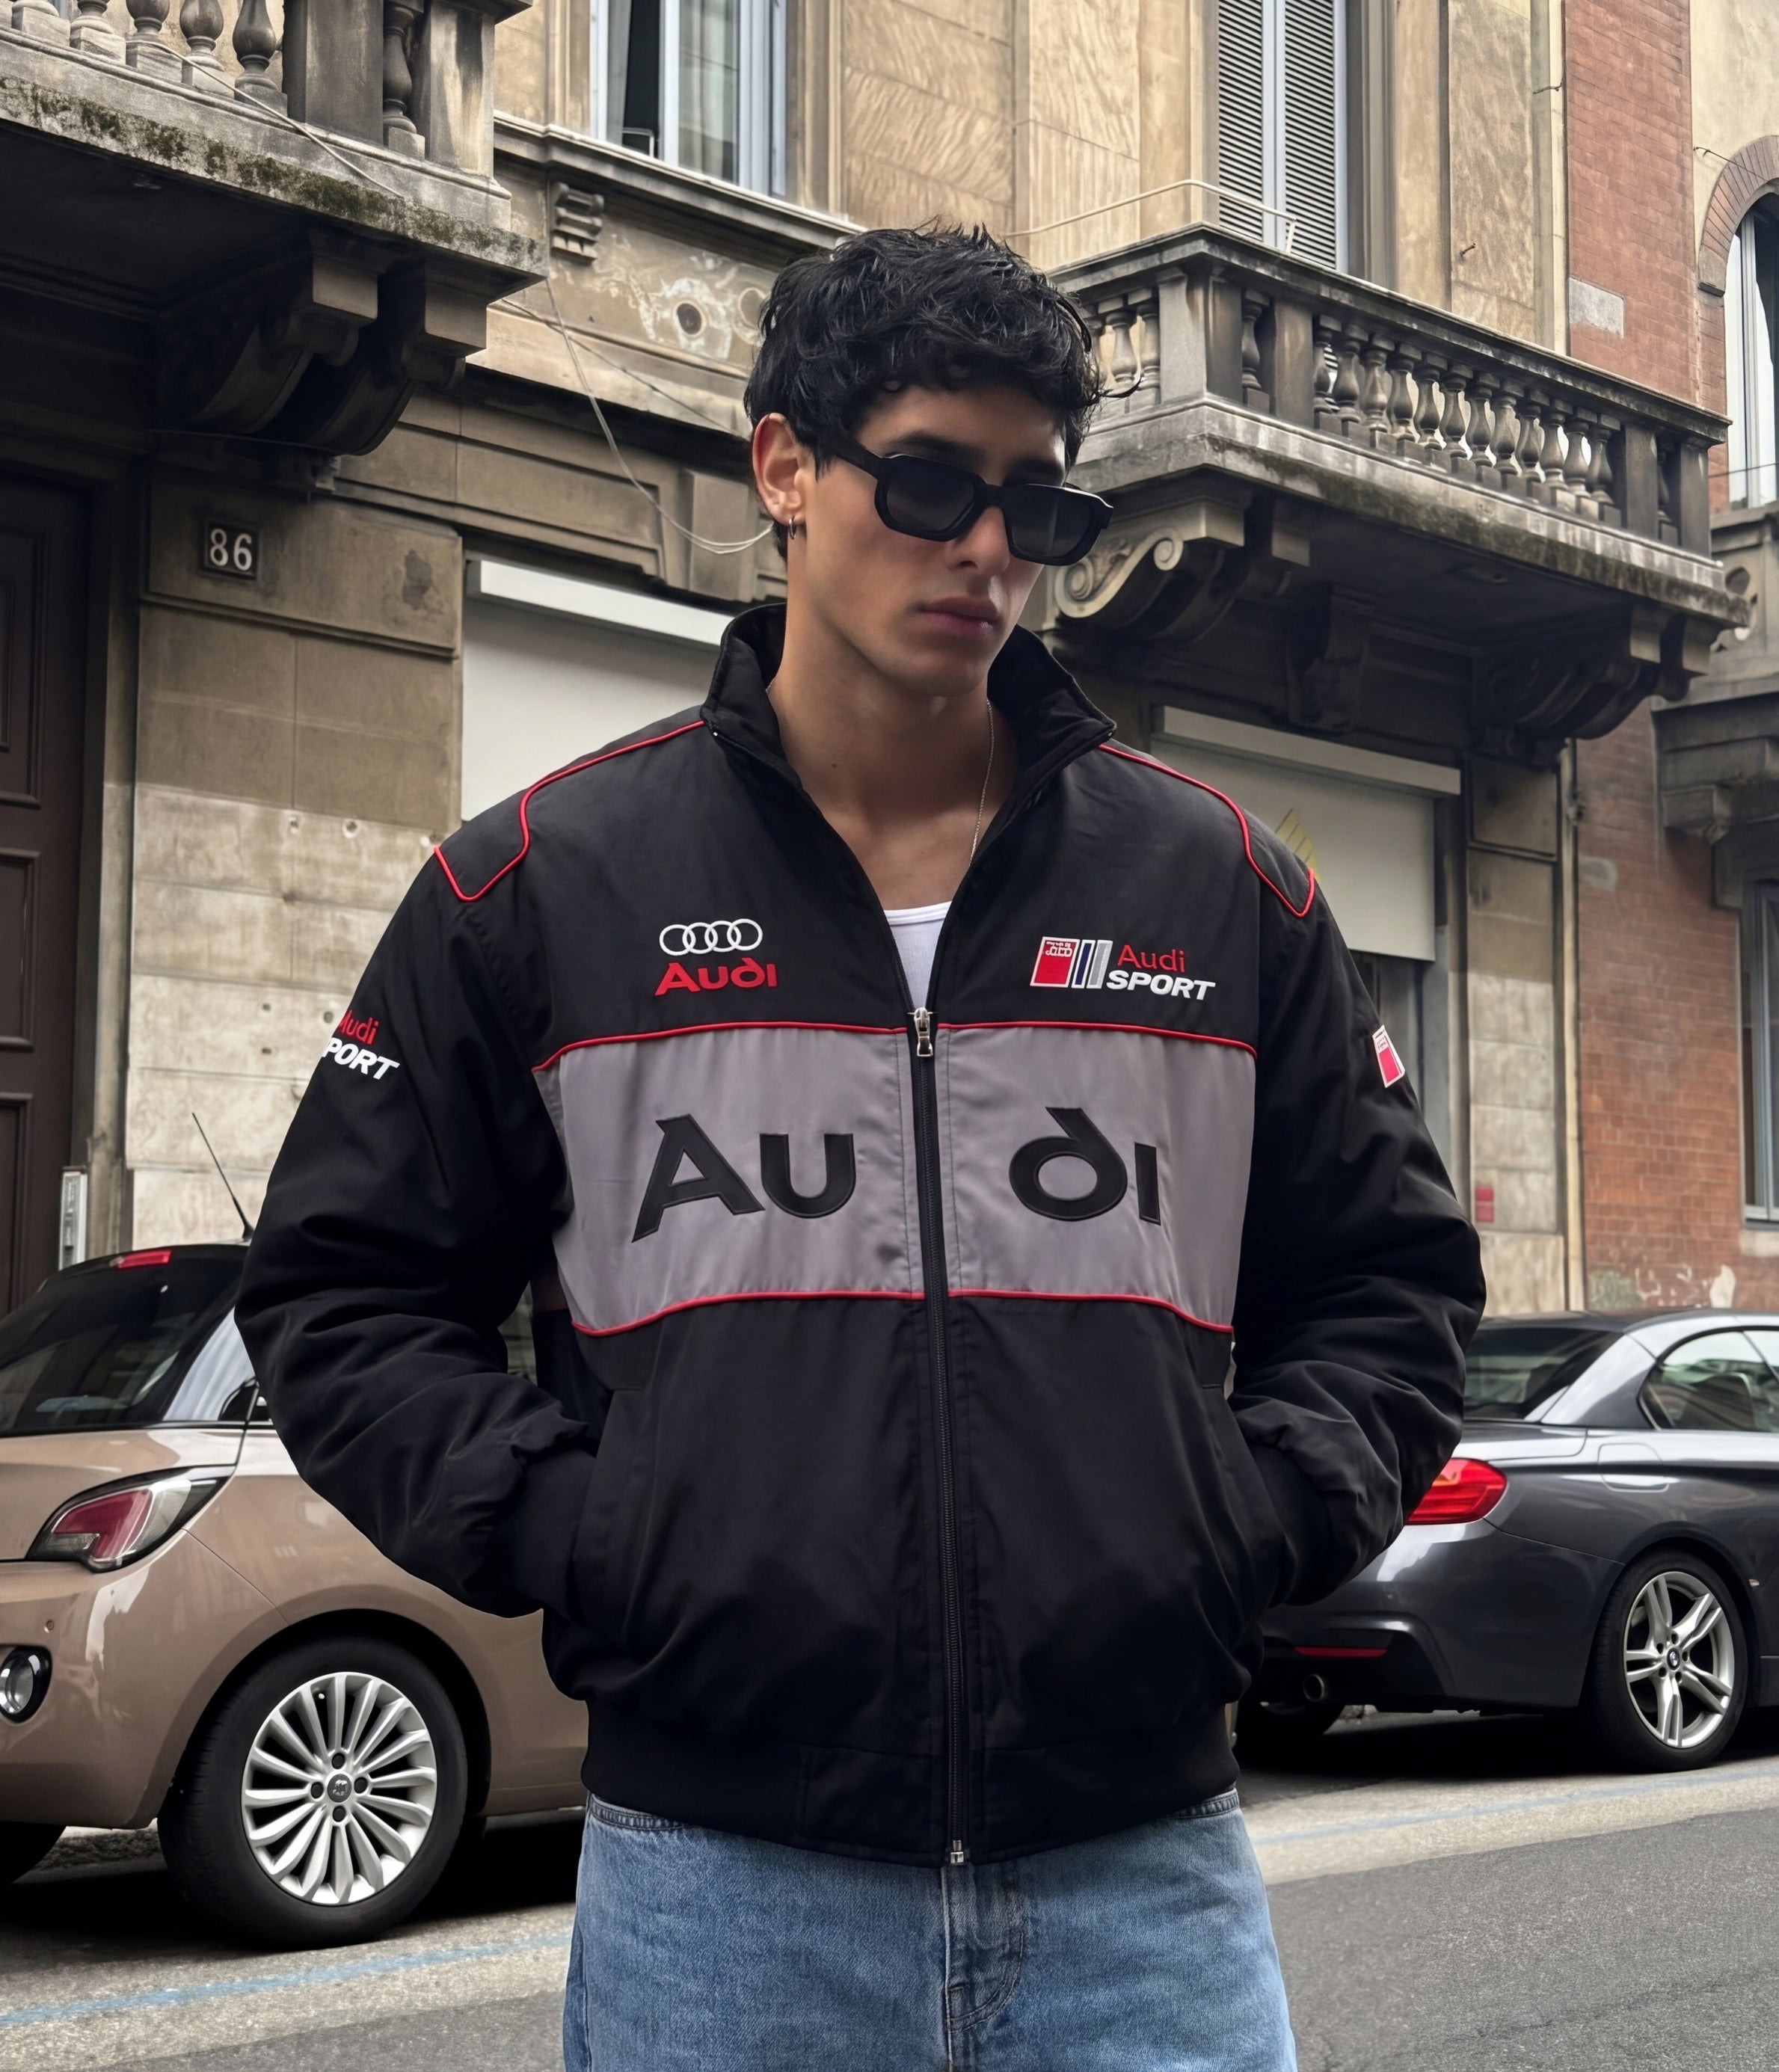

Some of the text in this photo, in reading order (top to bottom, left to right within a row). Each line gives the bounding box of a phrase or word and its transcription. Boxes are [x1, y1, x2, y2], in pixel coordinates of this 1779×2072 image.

[210, 528, 252, 571] 86
[655, 957, 777, 996] Audi
[1117, 944, 1185, 973] Audi
[1106, 970, 1216, 1000] SPORT
[322, 1037, 400, 1080] PORT
